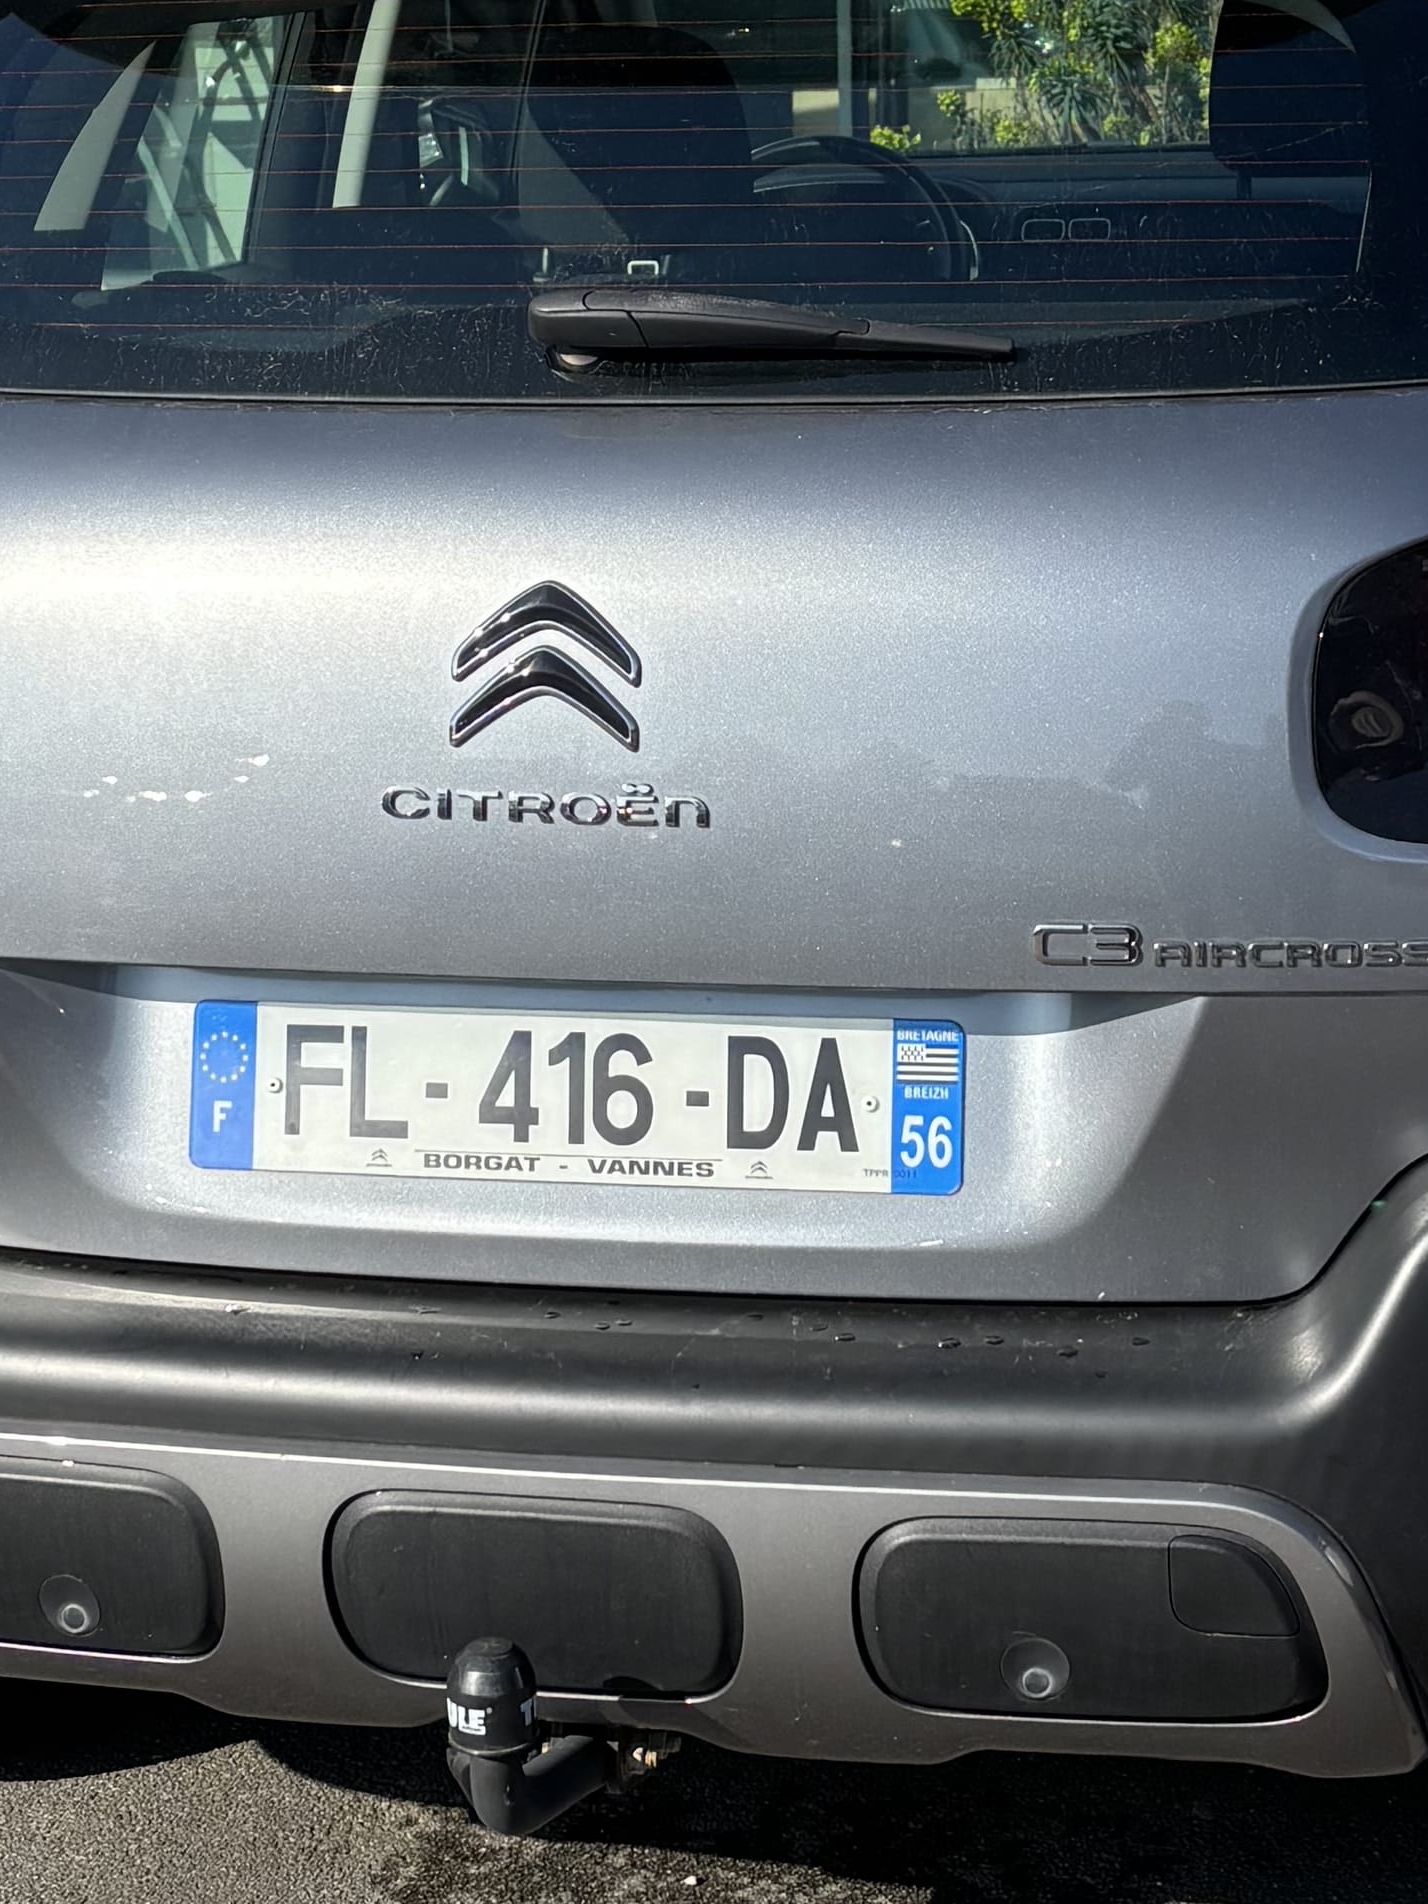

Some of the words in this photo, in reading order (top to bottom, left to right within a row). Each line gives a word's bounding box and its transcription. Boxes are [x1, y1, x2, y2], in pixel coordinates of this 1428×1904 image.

[1032, 922, 1143, 967] C3
[897, 1030, 959, 1041] BRETAGNE
[904, 1085, 949, 1100] BREIZH
[213, 1100, 232, 1132] F
[900, 1114, 953, 1169] 56
[424, 1153, 540, 1171] BORGAT
[588, 1159, 714, 1177] VANNES
